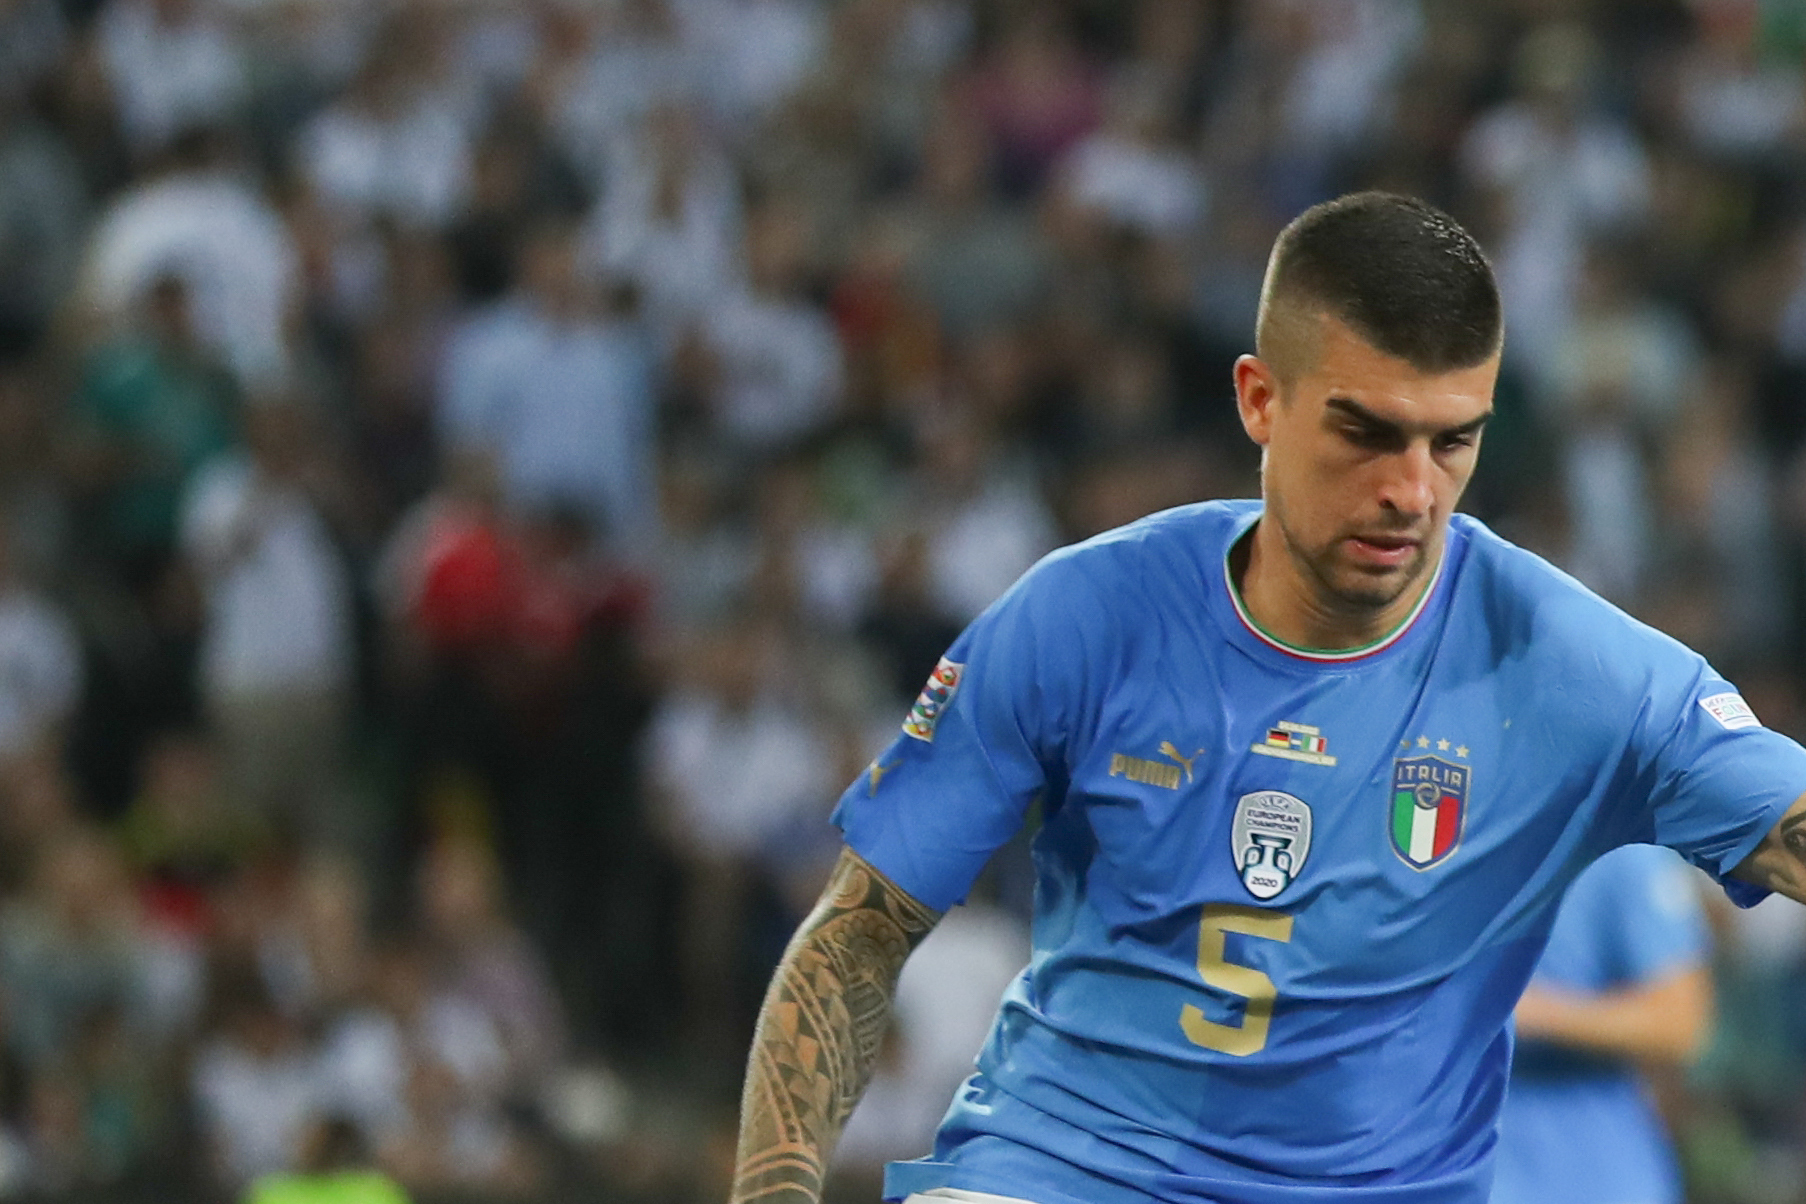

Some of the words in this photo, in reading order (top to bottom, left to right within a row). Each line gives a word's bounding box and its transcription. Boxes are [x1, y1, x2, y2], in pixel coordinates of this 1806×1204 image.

[1397, 765, 1462, 788] ITALIA
[1247, 809, 1301, 823] EUROPEAN
[1246, 819, 1299, 832] CHAMPIONS
[1251, 876, 1278, 888] 2020
[1178, 902, 1294, 1057] 5
